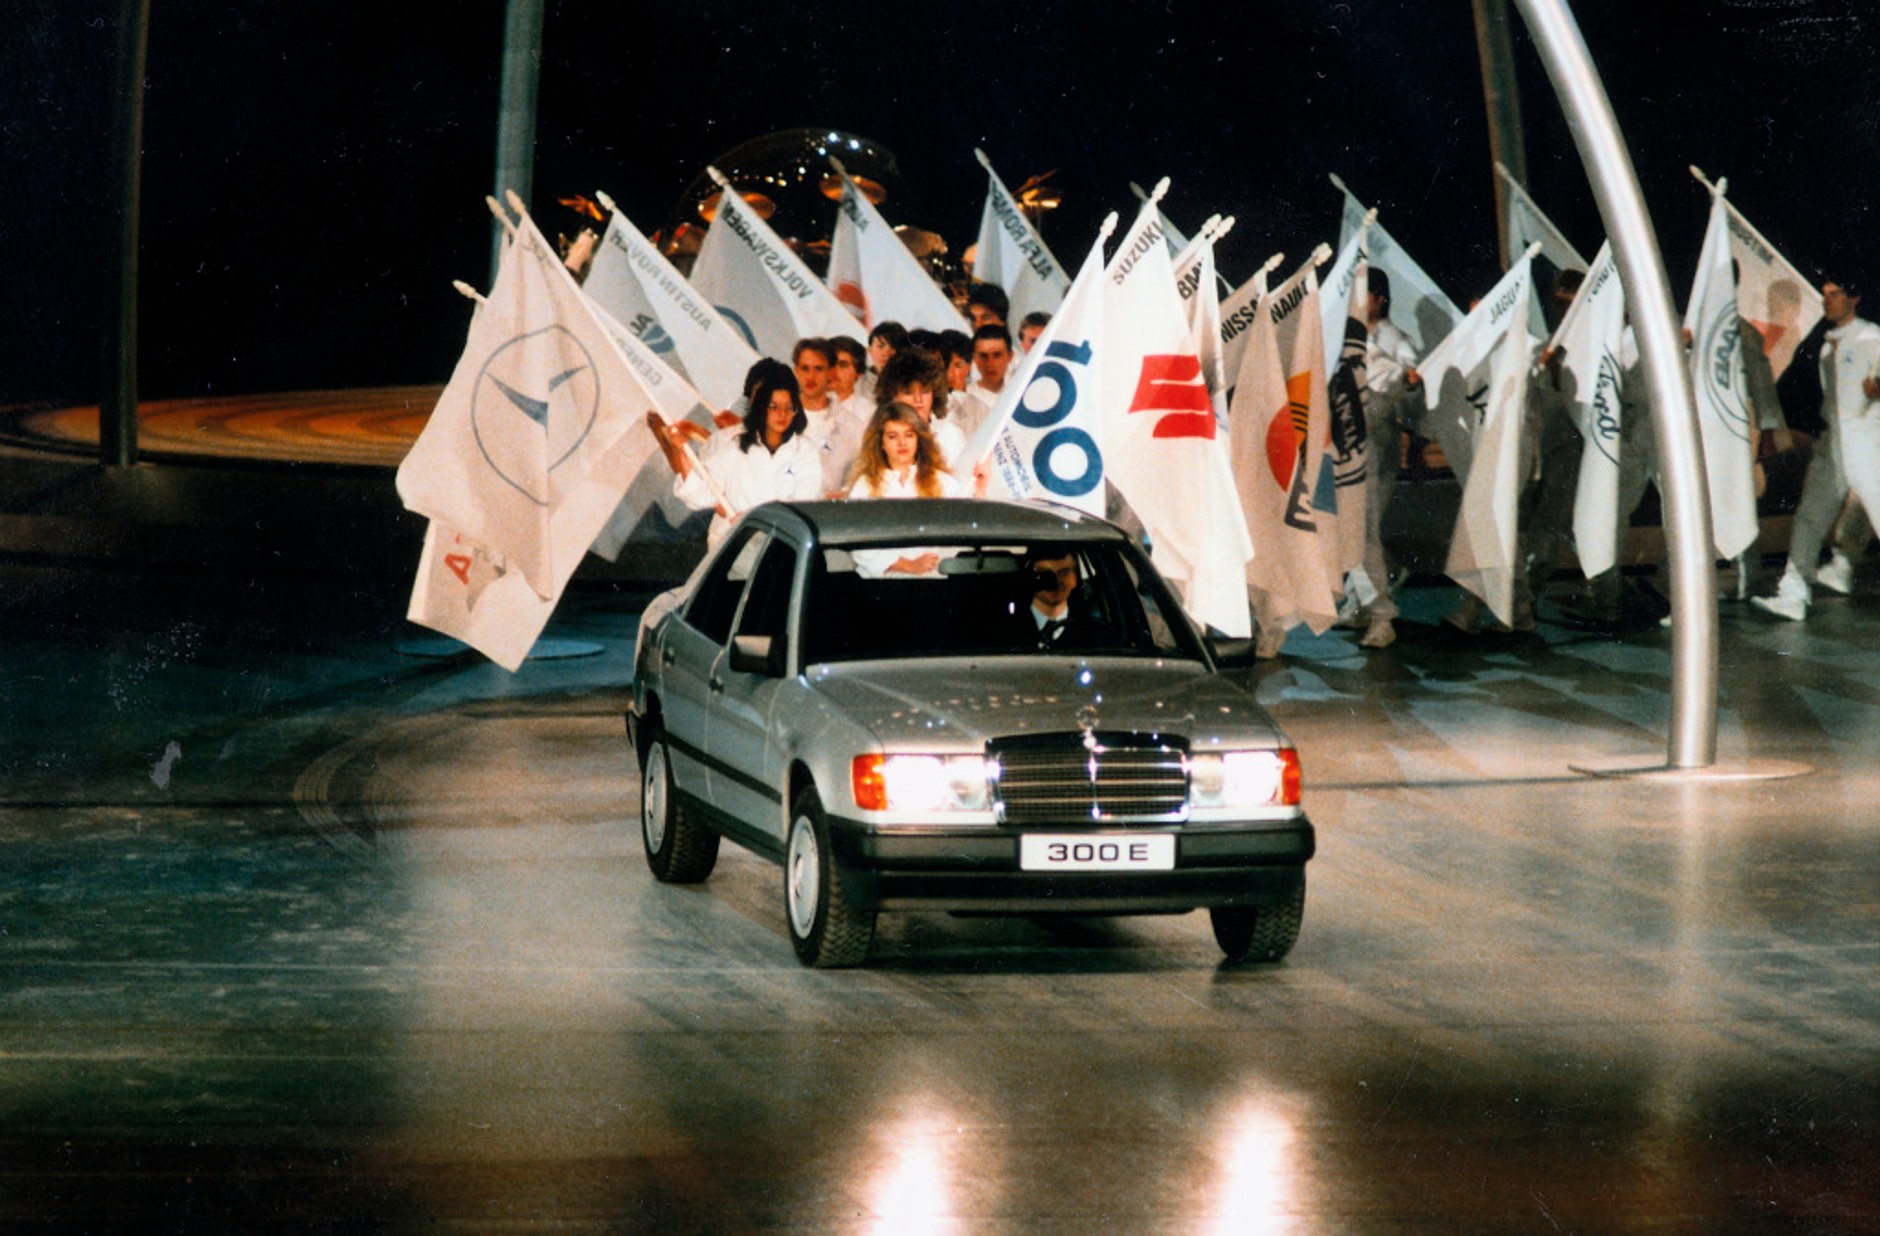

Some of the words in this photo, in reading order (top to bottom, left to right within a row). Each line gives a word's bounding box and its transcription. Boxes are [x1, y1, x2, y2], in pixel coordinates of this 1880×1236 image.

[1113, 220, 1165, 284] SUZUKI
[1177, 261, 1202, 300] BM
[1490, 278, 1521, 325] JAGU
[1221, 295, 1259, 342] NISSA
[1012, 340, 1103, 498] 100
[1048, 843, 1120, 862] 300
[1129, 843, 1149, 861] E
